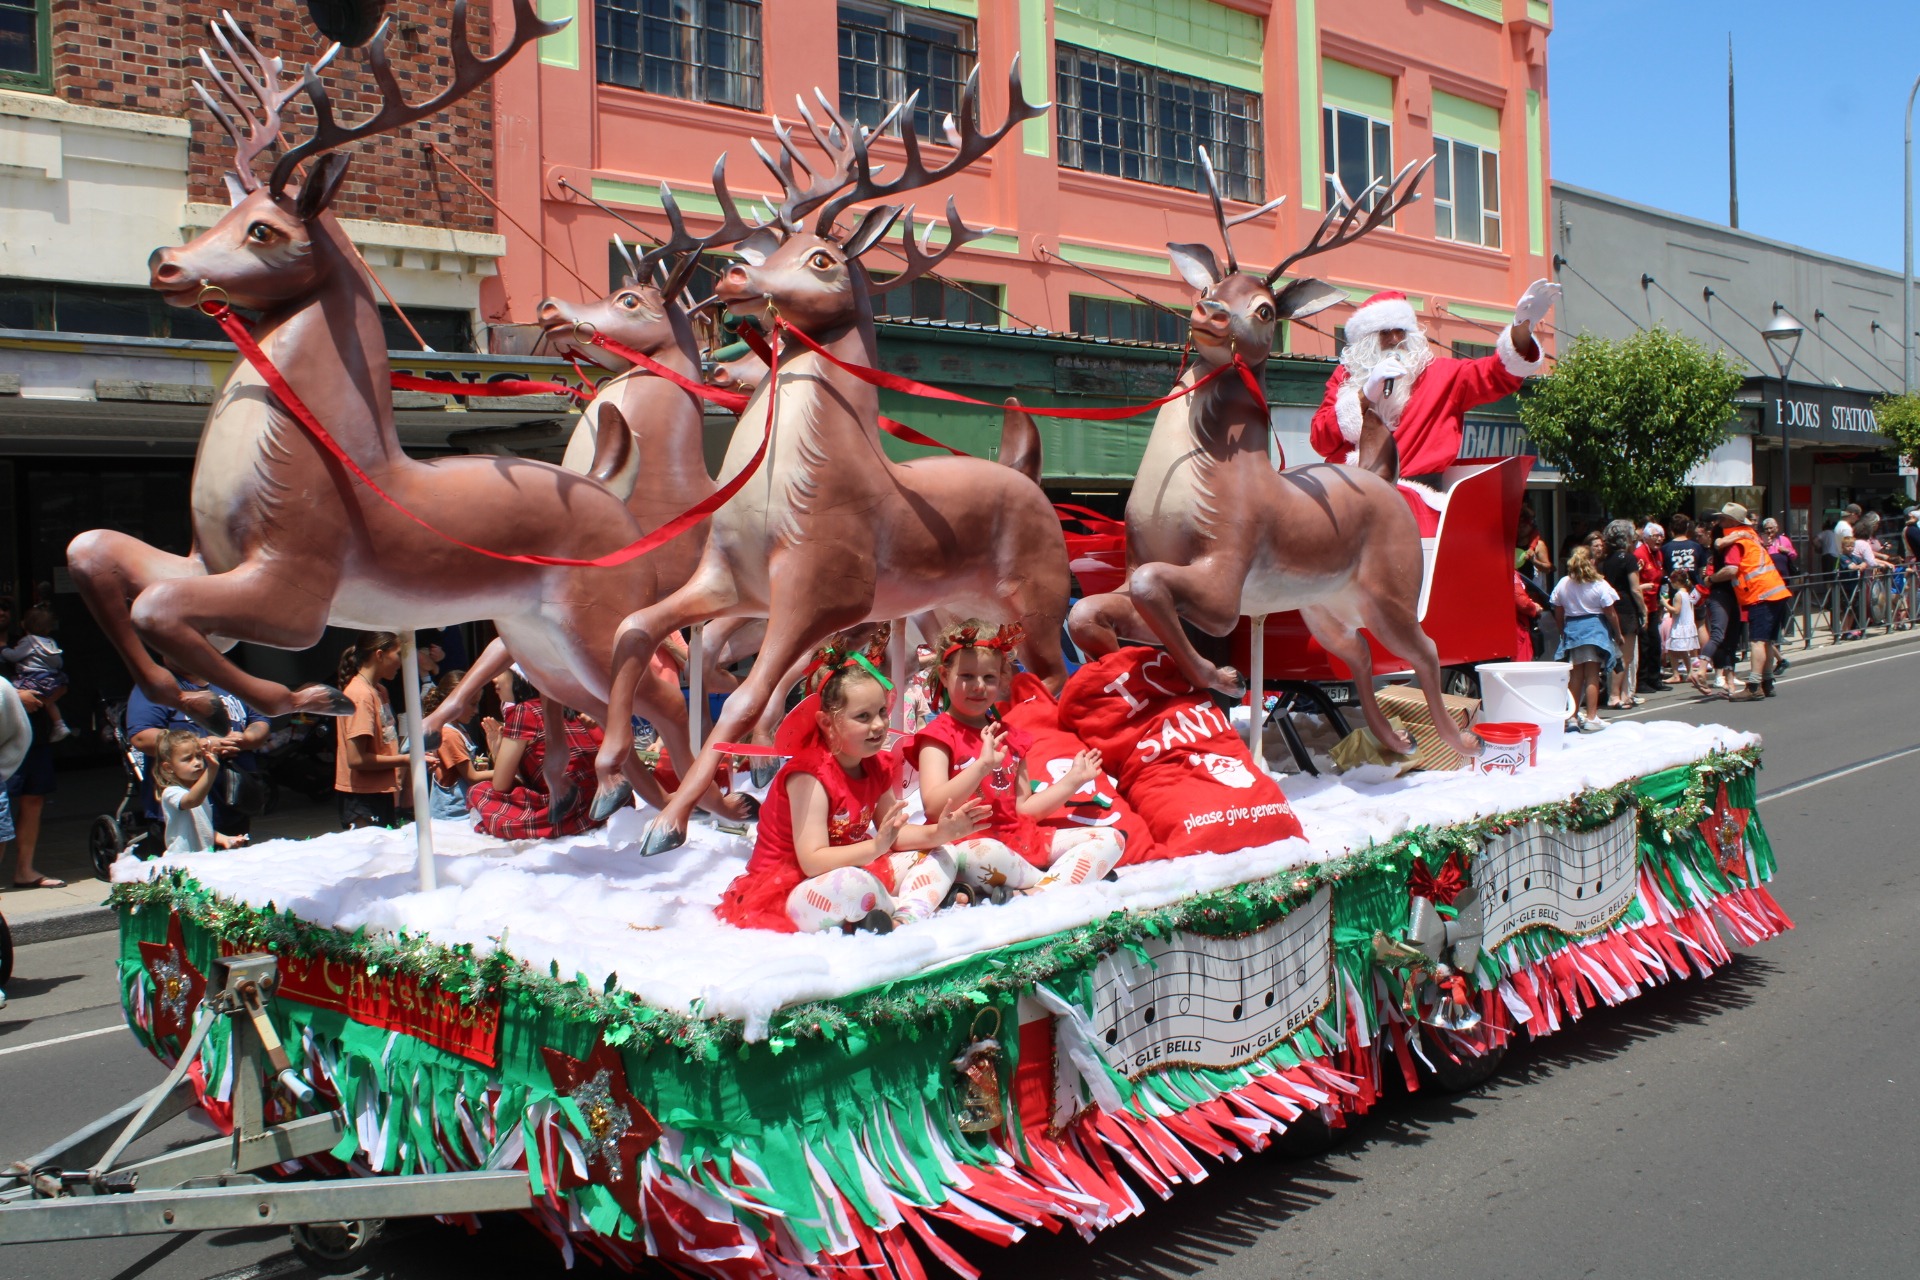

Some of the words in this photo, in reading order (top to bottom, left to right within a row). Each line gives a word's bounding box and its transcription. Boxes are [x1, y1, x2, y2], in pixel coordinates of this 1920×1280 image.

[1832, 405, 1881, 433] STATION
[1457, 425, 1527, 459] DHAND
[1671, 555, 1695, 569] 22
[1103, 671, 1149, 718] I
[1136, 701, 1231, 763] SANT
[1183, 808, 1224, 834] please
[1226, 805, 1250, 826] give
[1608, 896, 1629, 915] BELLS
[1502, 909, 1535, 934] JIN-GLE
[1538, 908, 1559, 921] BELLS
[1230, 1026, 1281, 1058] JIN-GLE
[1286, 996, 1320, 1029] BELLS
[1166, 1040, 1202, 1054] BELLS
